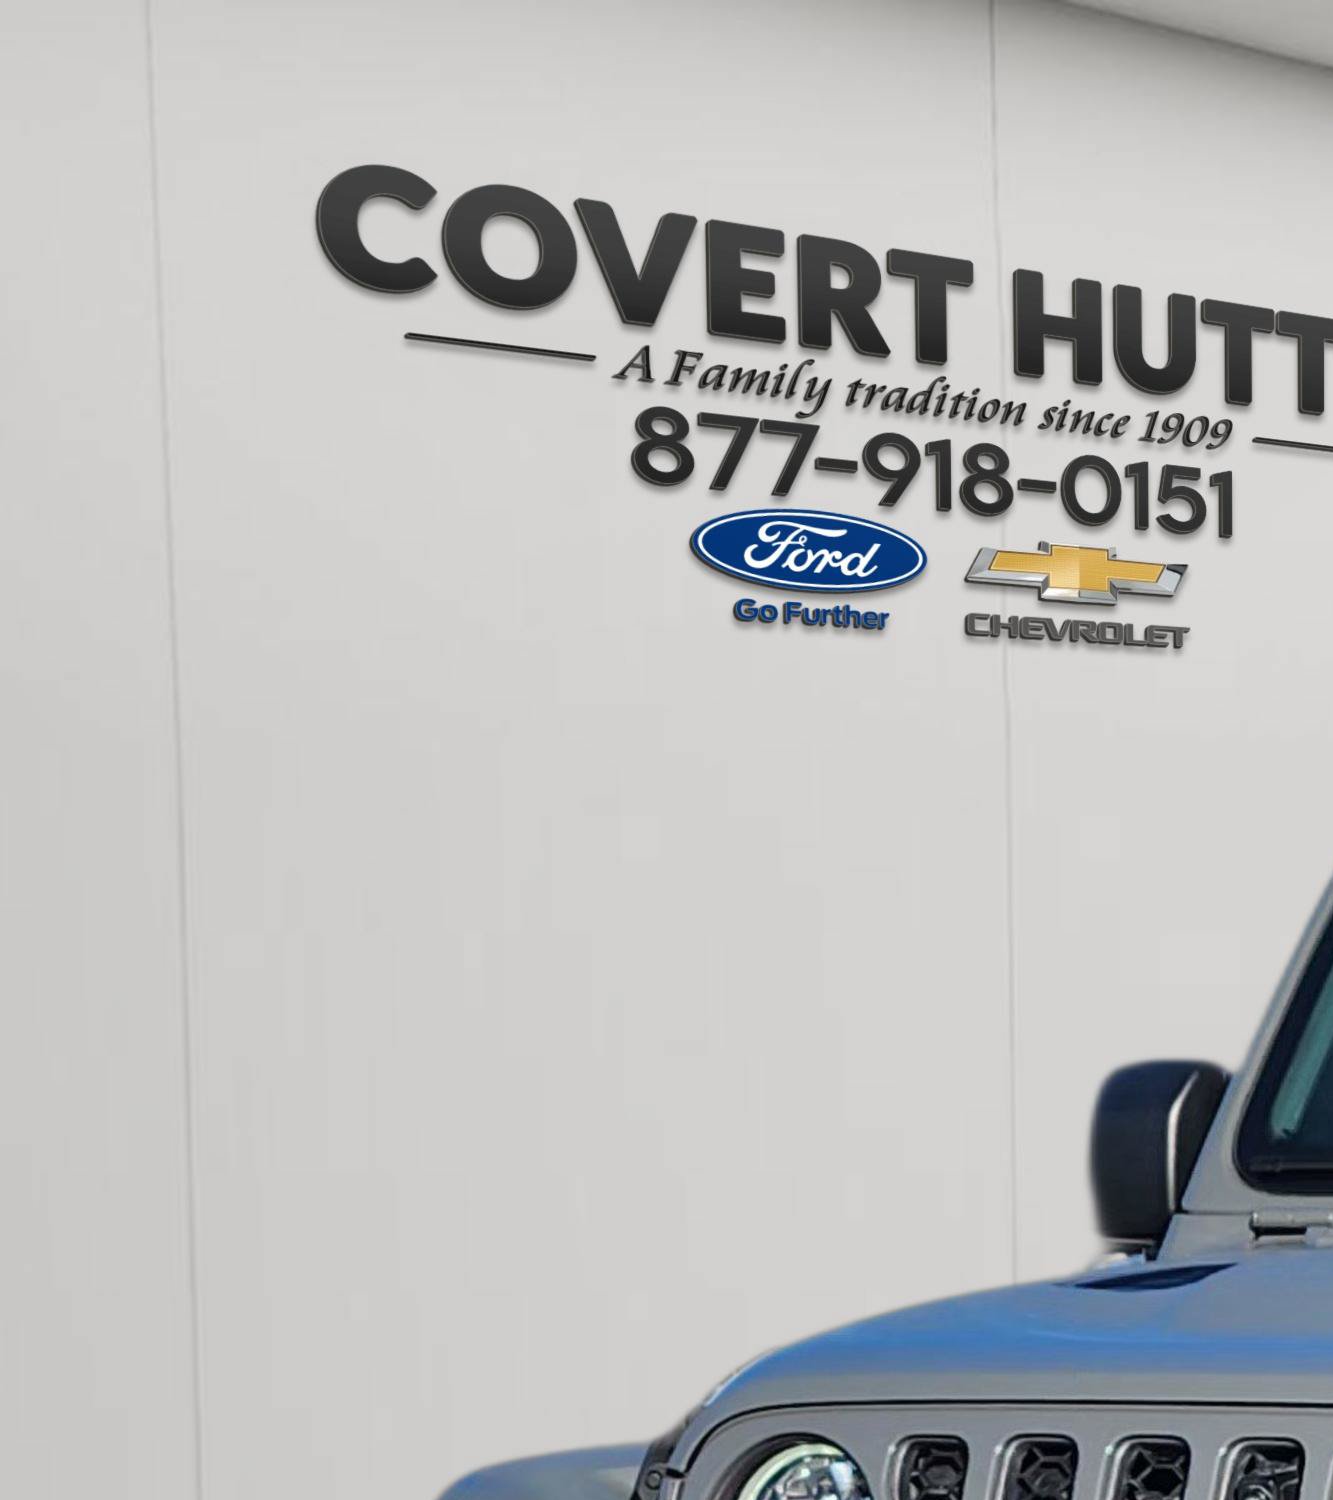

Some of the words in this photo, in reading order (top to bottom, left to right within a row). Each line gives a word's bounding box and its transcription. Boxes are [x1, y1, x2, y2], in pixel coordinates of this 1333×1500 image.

[316, 164, 974, 366] COVERT
[611, 345, 655, 384] A
[664, 350, 832, 419] Family
[846, 376, 1026, 427] tradition
[1037, 399, 1131, 439] since
[1138, 410, 1234, 451] 1909
[630, 406, 1233, 540] 877-918-0151
[743, 519, 882, 579] Ford
[733, 598, 778, 625] Go
[783, 601, 890, 631] Further
[964, 612, 1191, 650] CHEVROLET
